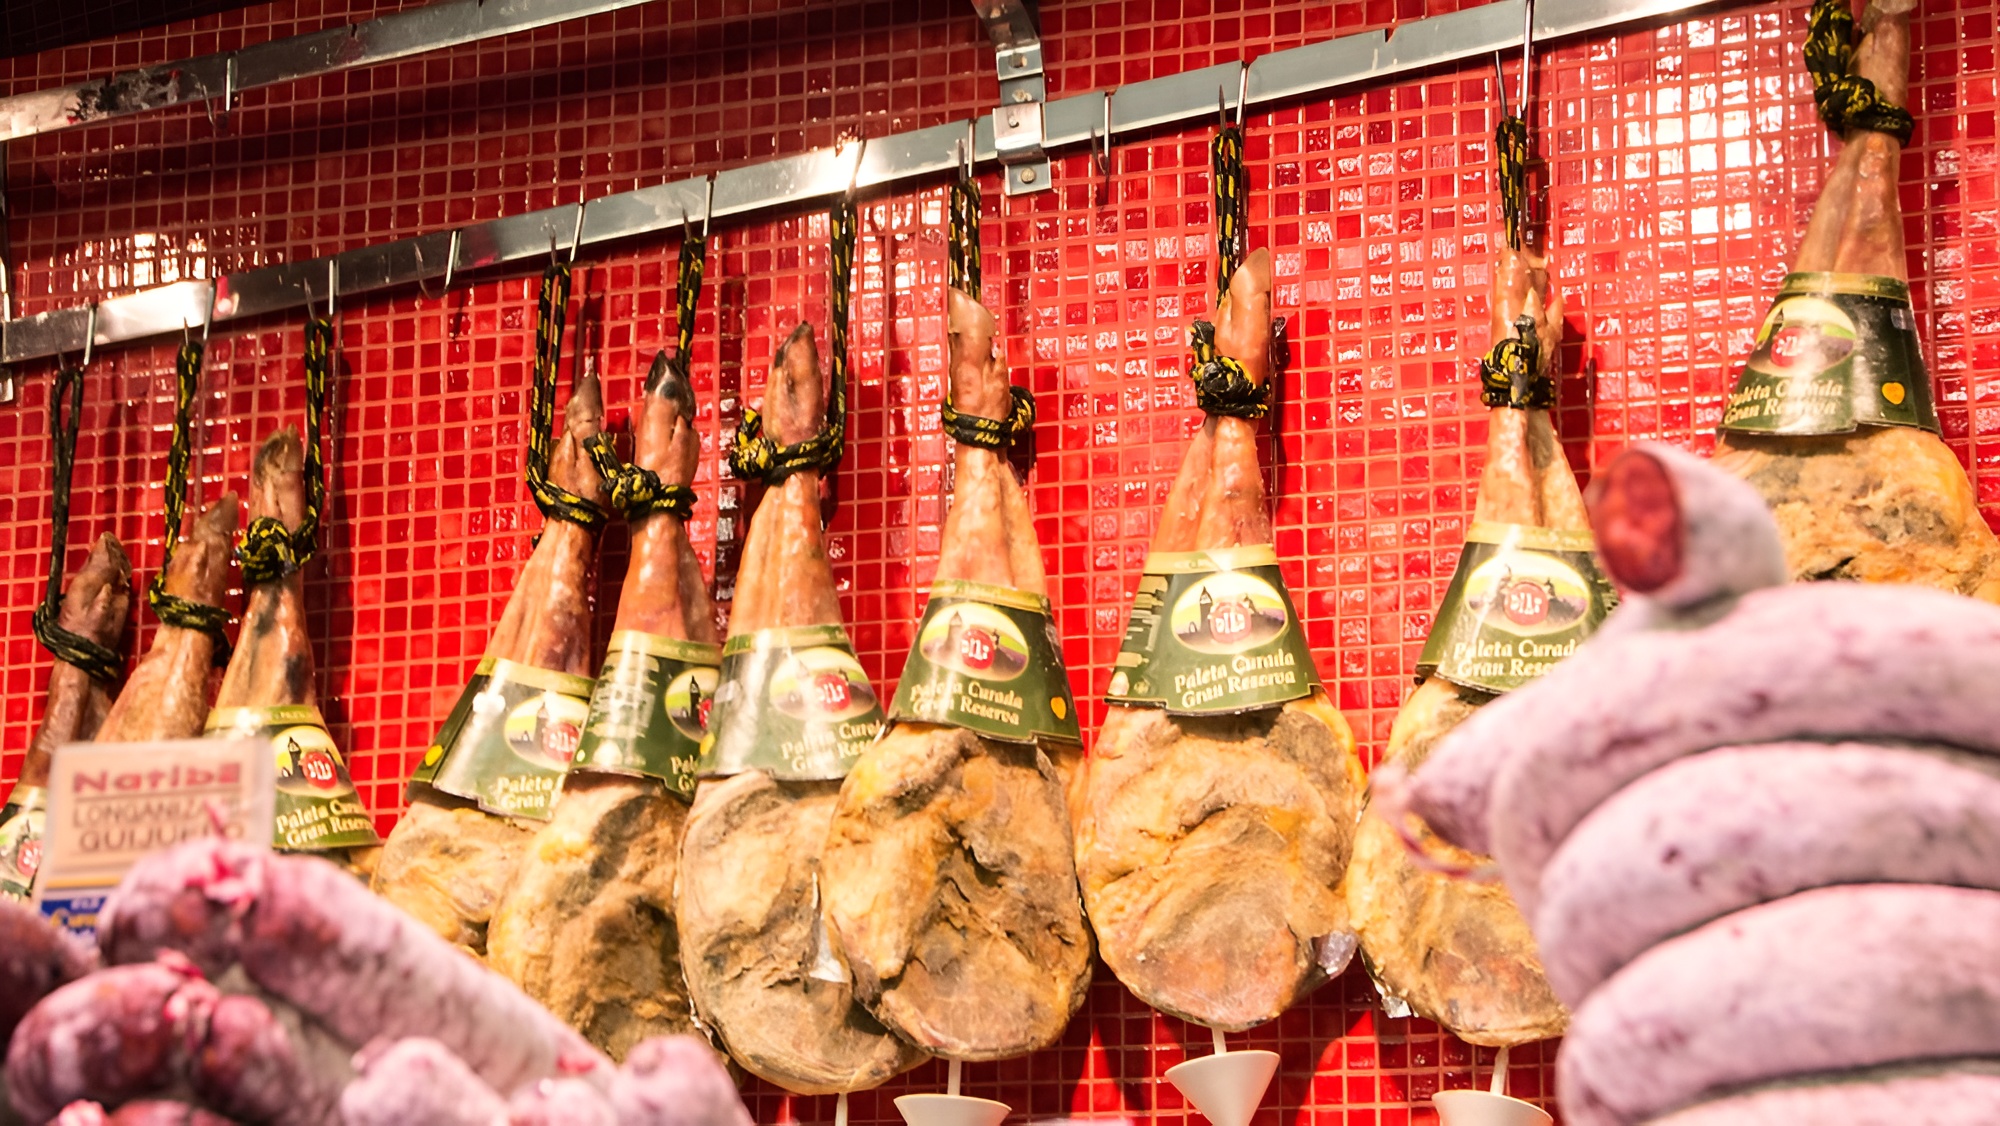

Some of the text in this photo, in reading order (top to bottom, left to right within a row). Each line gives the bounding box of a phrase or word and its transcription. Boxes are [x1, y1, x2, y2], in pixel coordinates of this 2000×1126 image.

[1775, 379, 1843, 397] Cada
[1724, 397, 1837, 425] Gran Rerva
[1453, 638, 1581, 660] Paleta Curad
[1175, 648, 1296, 693] Paleta Curada
[1457, 658, 1555, 678] Gran Rese
[968, 680, 1024, 710] Curada
[1181, 670, 1297, 708] Gran Reserva
[960, 694, 1020, 725] Reserva
[839, 719, 885, 739] Curad
[671, 754, 699, 775] Pal
[792, 749, 836, 772] Gr
[496, 775, 554, 796] Paleta
[678, 774, 696, 791] Gr
[501, 792, 546, 809] Gran
[276, 804, 329, 835] Paleta
[286, 815, 374, 846] Gran Reser
[79, 820, 244, 853] GUIJUO
